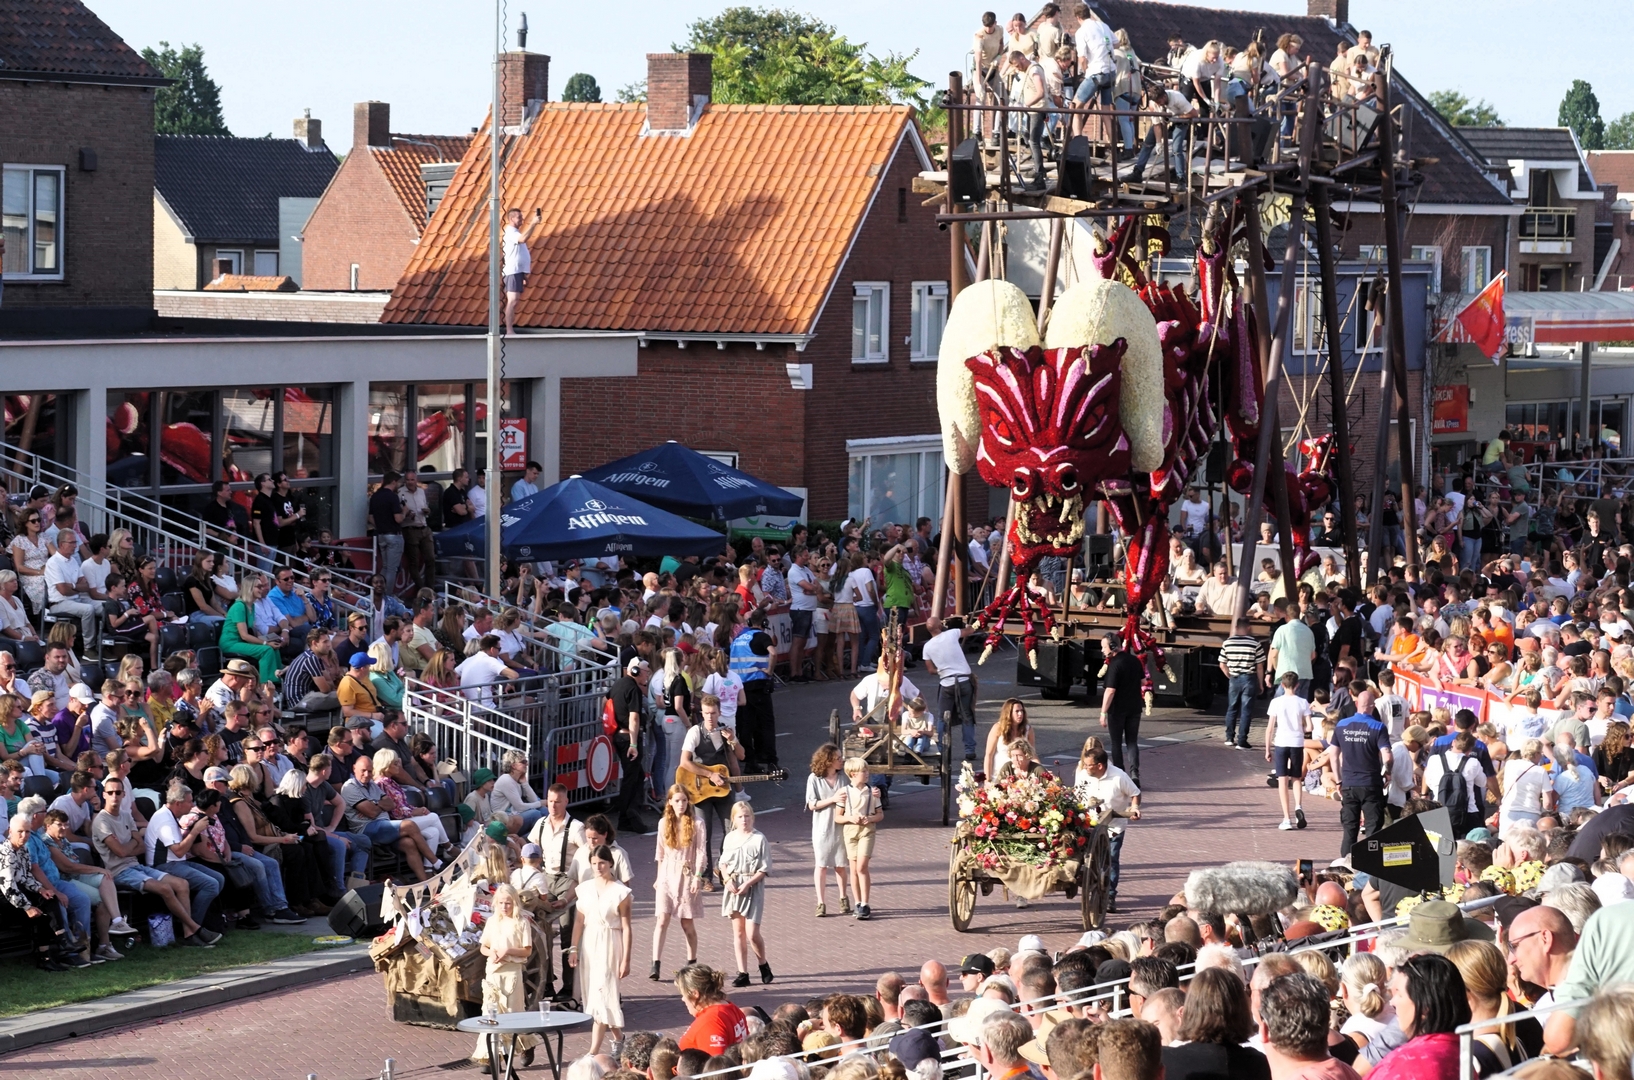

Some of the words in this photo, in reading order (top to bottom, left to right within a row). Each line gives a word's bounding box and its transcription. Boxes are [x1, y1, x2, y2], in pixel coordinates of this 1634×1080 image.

[1506, 325, 1529, 343] ress
[600, 471, 671, 488] Affligem
[568, 512, 648, 530] Affligem
[605, 542, 633, 552] Affligem
[1343, 728, 1370, 737] Scorpions
[1344, 735, 1367, 744] Security
